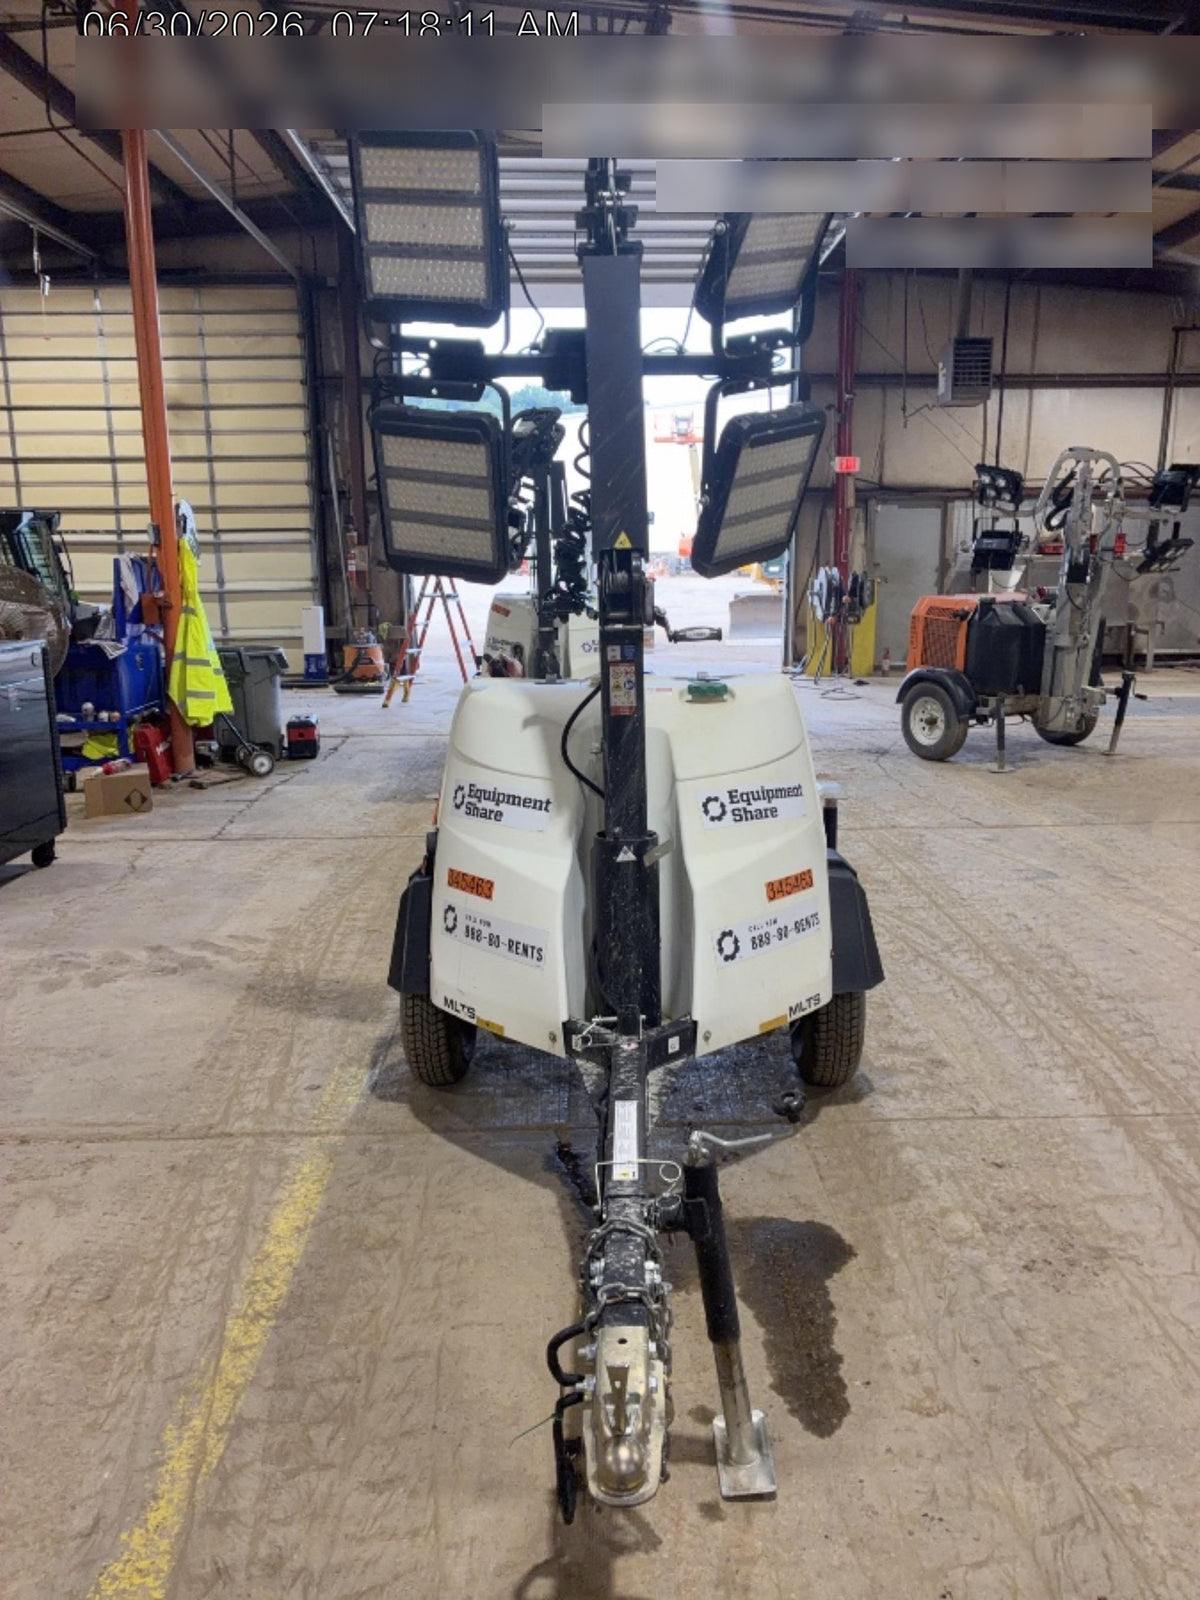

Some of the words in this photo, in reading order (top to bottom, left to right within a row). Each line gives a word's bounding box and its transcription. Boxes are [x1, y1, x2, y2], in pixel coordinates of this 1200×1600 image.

[467, 783, 552, 813] Equipment
[727, 783, 804, 805] Equipment
[464, 801, 504, 822] Share
[731, 806, 778, 822] Share
[767, 870, 814, 900] 345463
[443, 995, 476, 1019] MLTS
[788, 993, 821, 1018] MLTS
